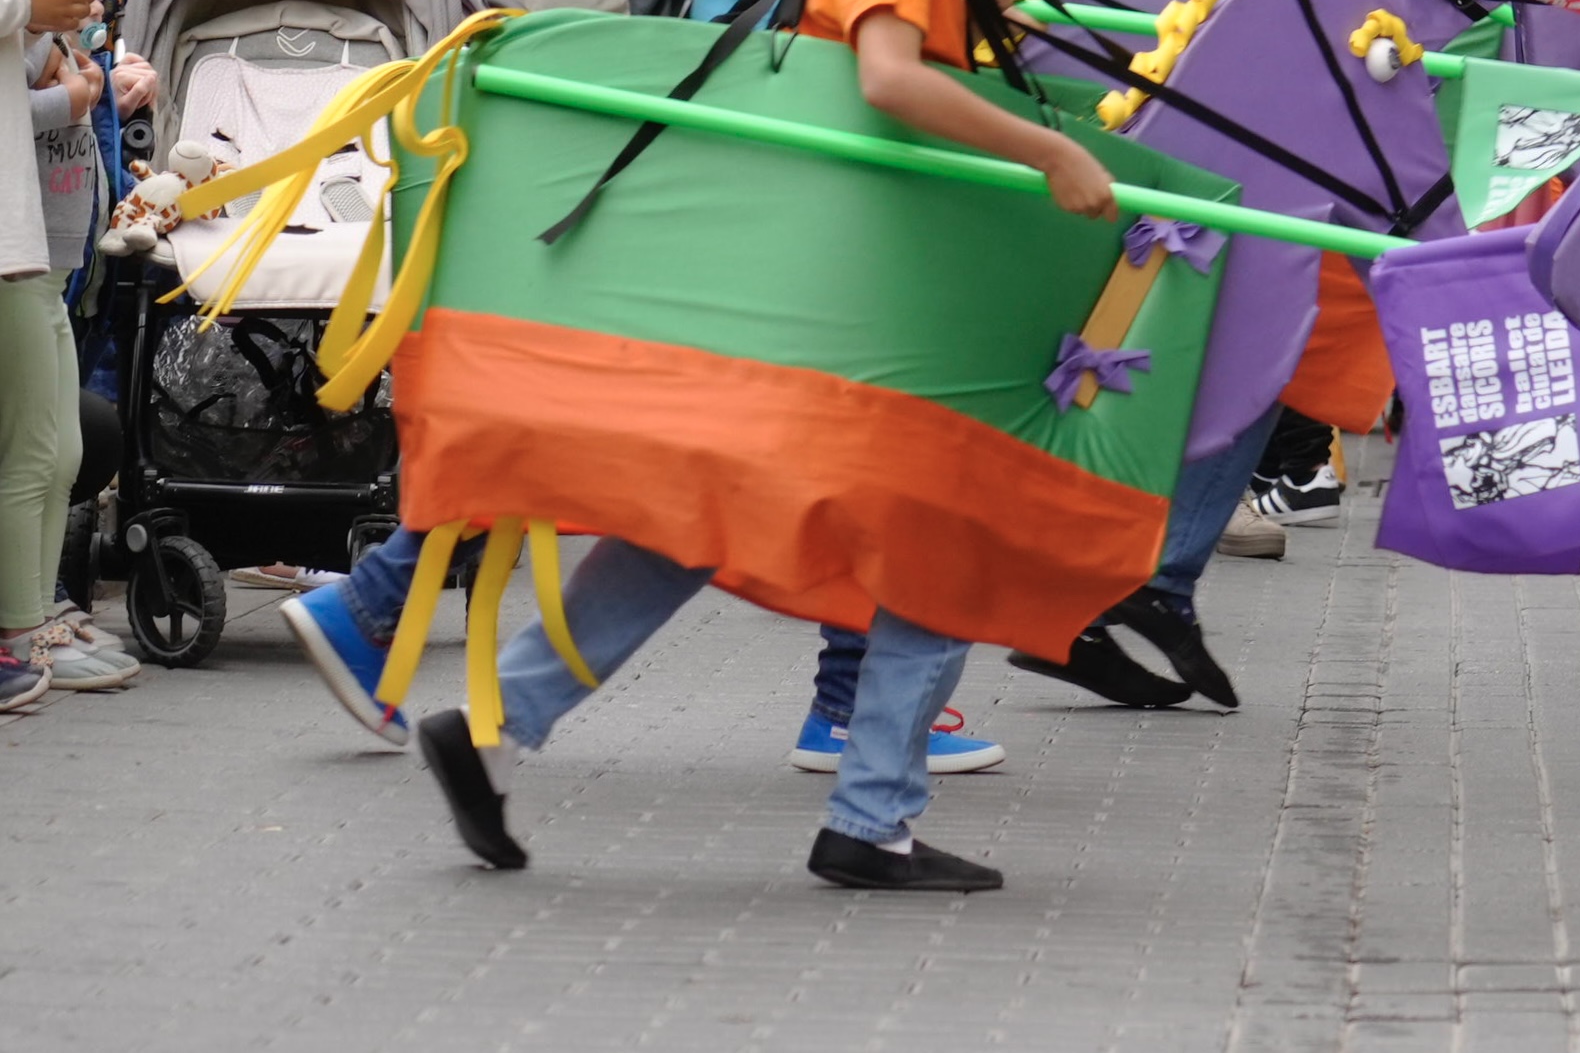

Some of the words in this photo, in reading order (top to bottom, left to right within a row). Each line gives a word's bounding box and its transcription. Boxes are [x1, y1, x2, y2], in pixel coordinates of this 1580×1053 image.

[1449, 322, 1480, 424] dansaire
[1466, 318, 1506, 421] SICORIS
[1504, 314, 1534, 414] ballet
[1522, 312, 1545, 343] de
[1542, 309, 1577, 407] LLEIDA
[1420, 327, 1460, 429] ESBART
[1526, 345, 1552, 411] ciutat
